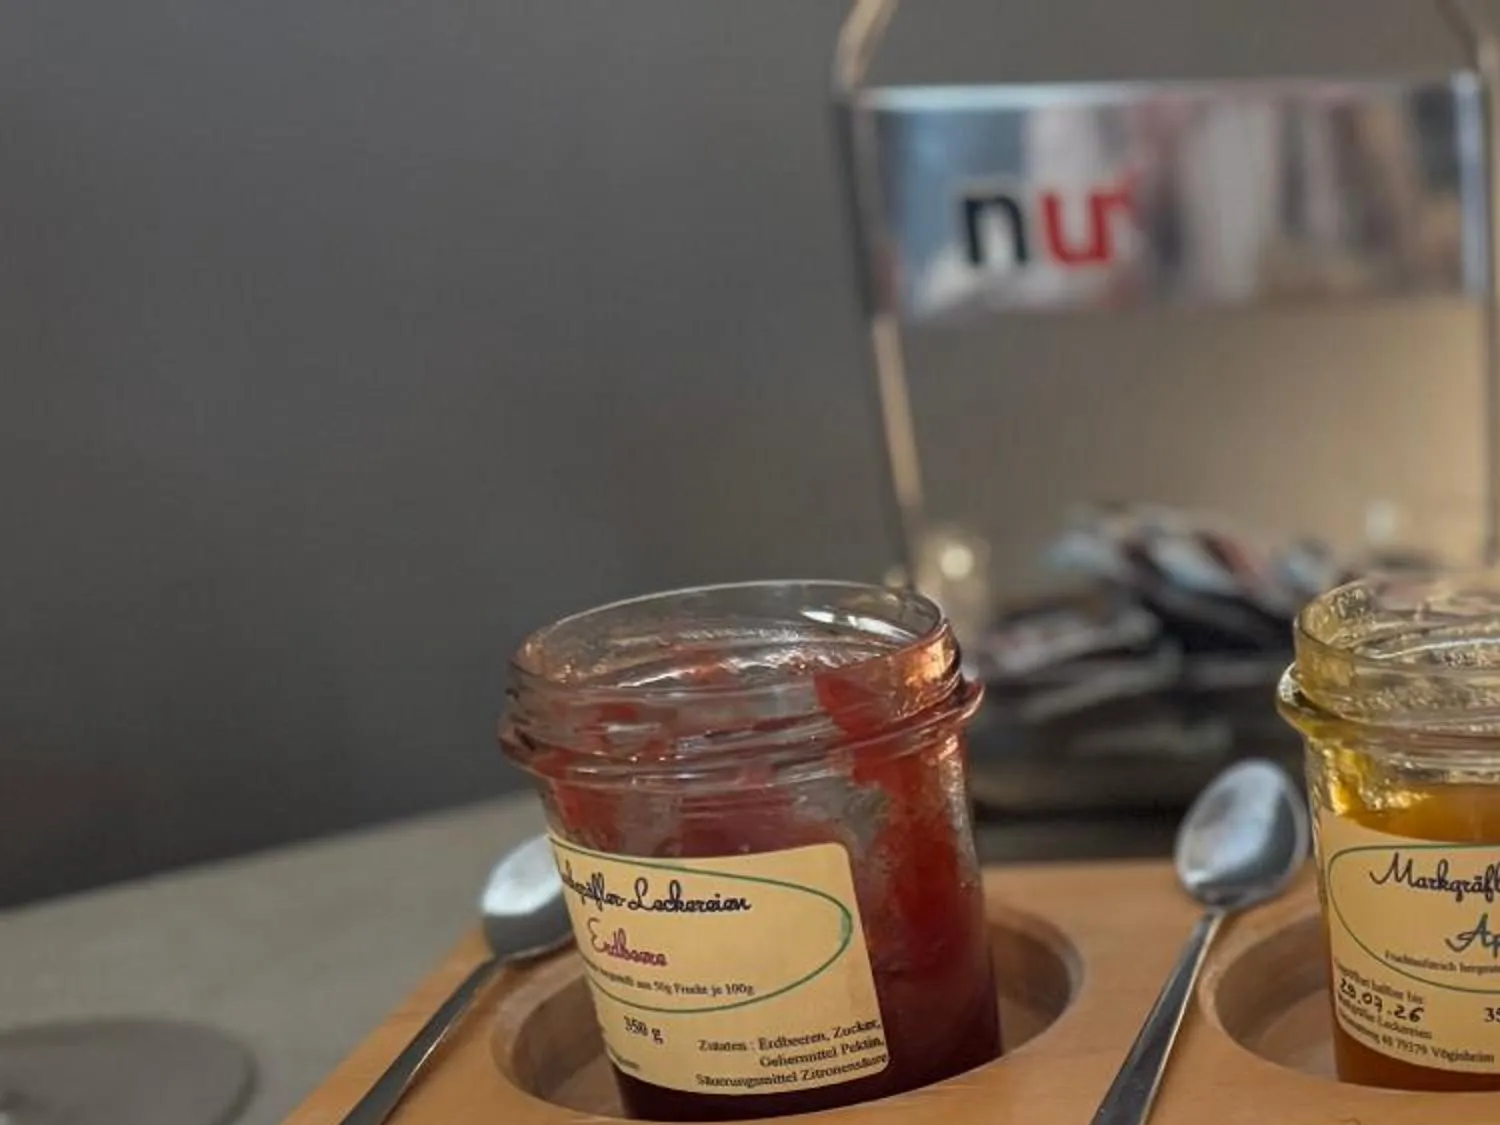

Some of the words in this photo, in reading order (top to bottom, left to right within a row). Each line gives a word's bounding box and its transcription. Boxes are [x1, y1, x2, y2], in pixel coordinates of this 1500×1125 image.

[587, 917, 668, 966] Erdbeere
[624, 1015, 648, 1037] 350
[652, 1027, 664, 1045] g
[758, 1032, 830, 1051] Erdbeeren,
[833, 1019, 881, 1038] Zucker,
